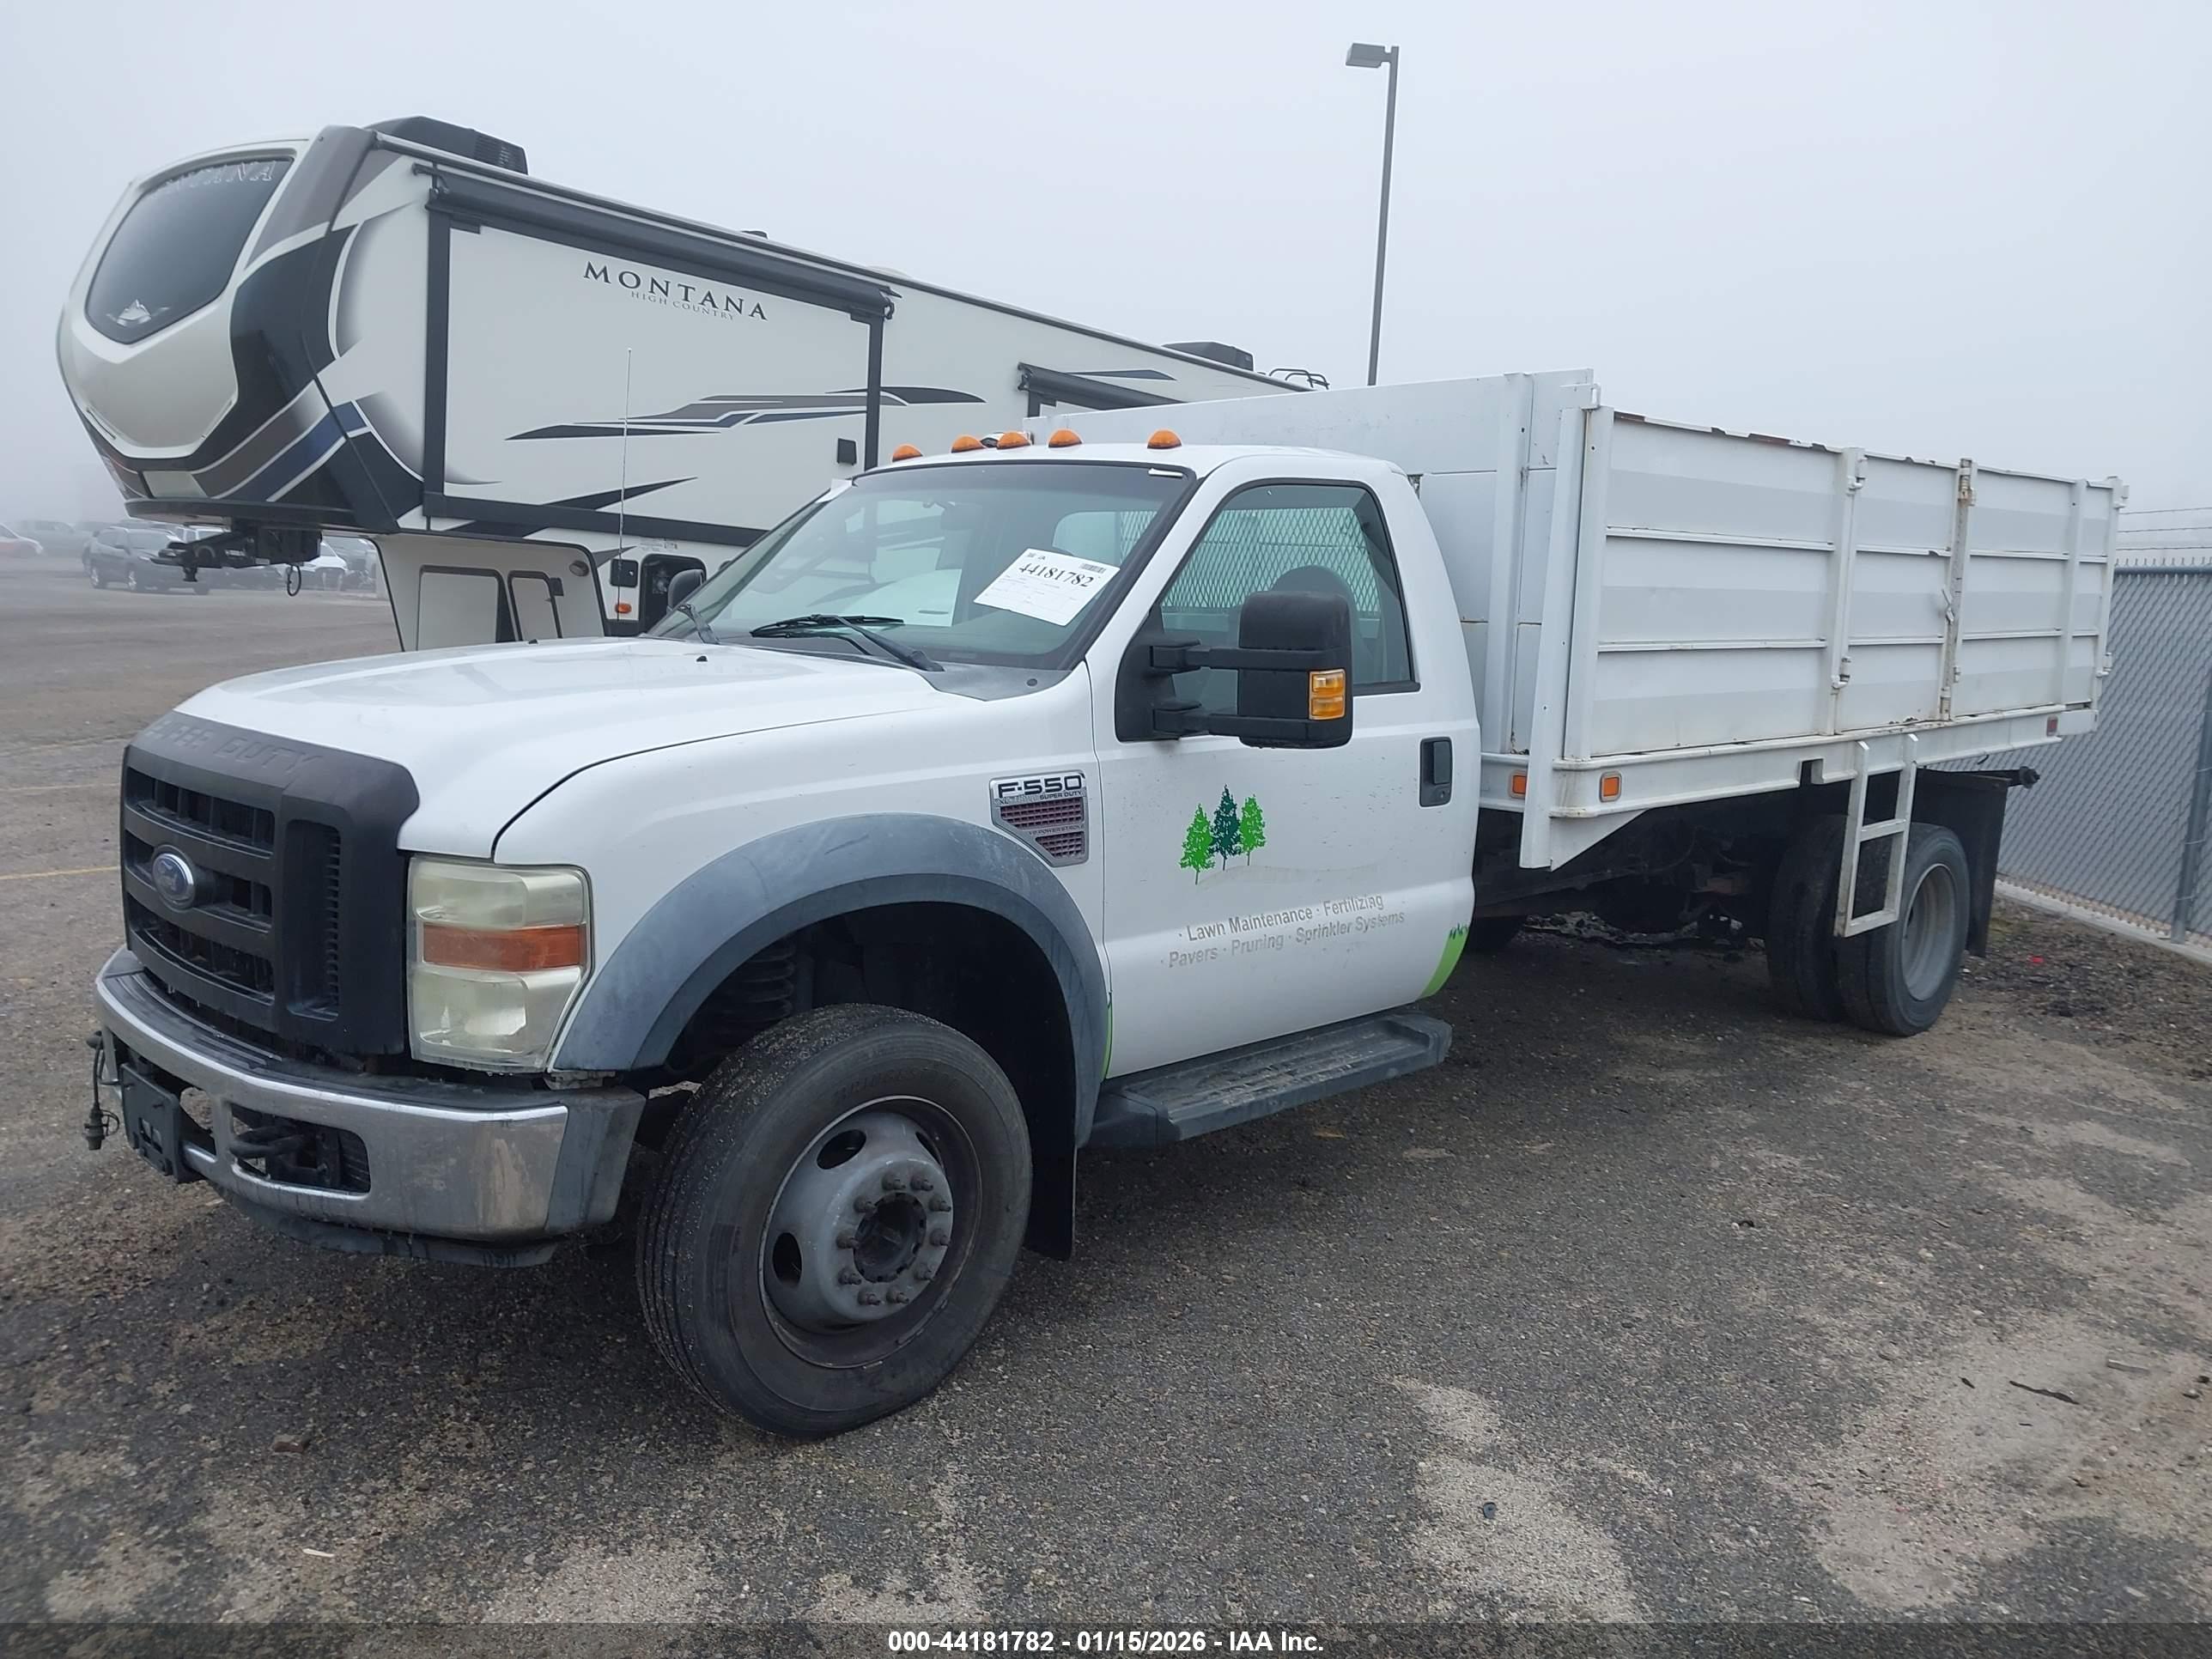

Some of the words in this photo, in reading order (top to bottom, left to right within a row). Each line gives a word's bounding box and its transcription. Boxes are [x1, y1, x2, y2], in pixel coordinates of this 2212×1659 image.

[583, 260, 768, 320] MONTANA
[631, 290, 667, 305] HIGH
[672, 301, 733, 320] COUNTRY
[1018, 562, 1095, 587] 44181782
[1169, 946, 1218, 969] Pavers
[1231, 933, 1285, 956] Pruning
[1296, 920, 1353, 945] Sprinkler
[1355, 910, 1406, 933] Systems
[1187, 925, 1226, 942] Lawn
[1228, 907, 1313, 934] Maintenance
[1323, 894, 1384, 917] Fertilizing
